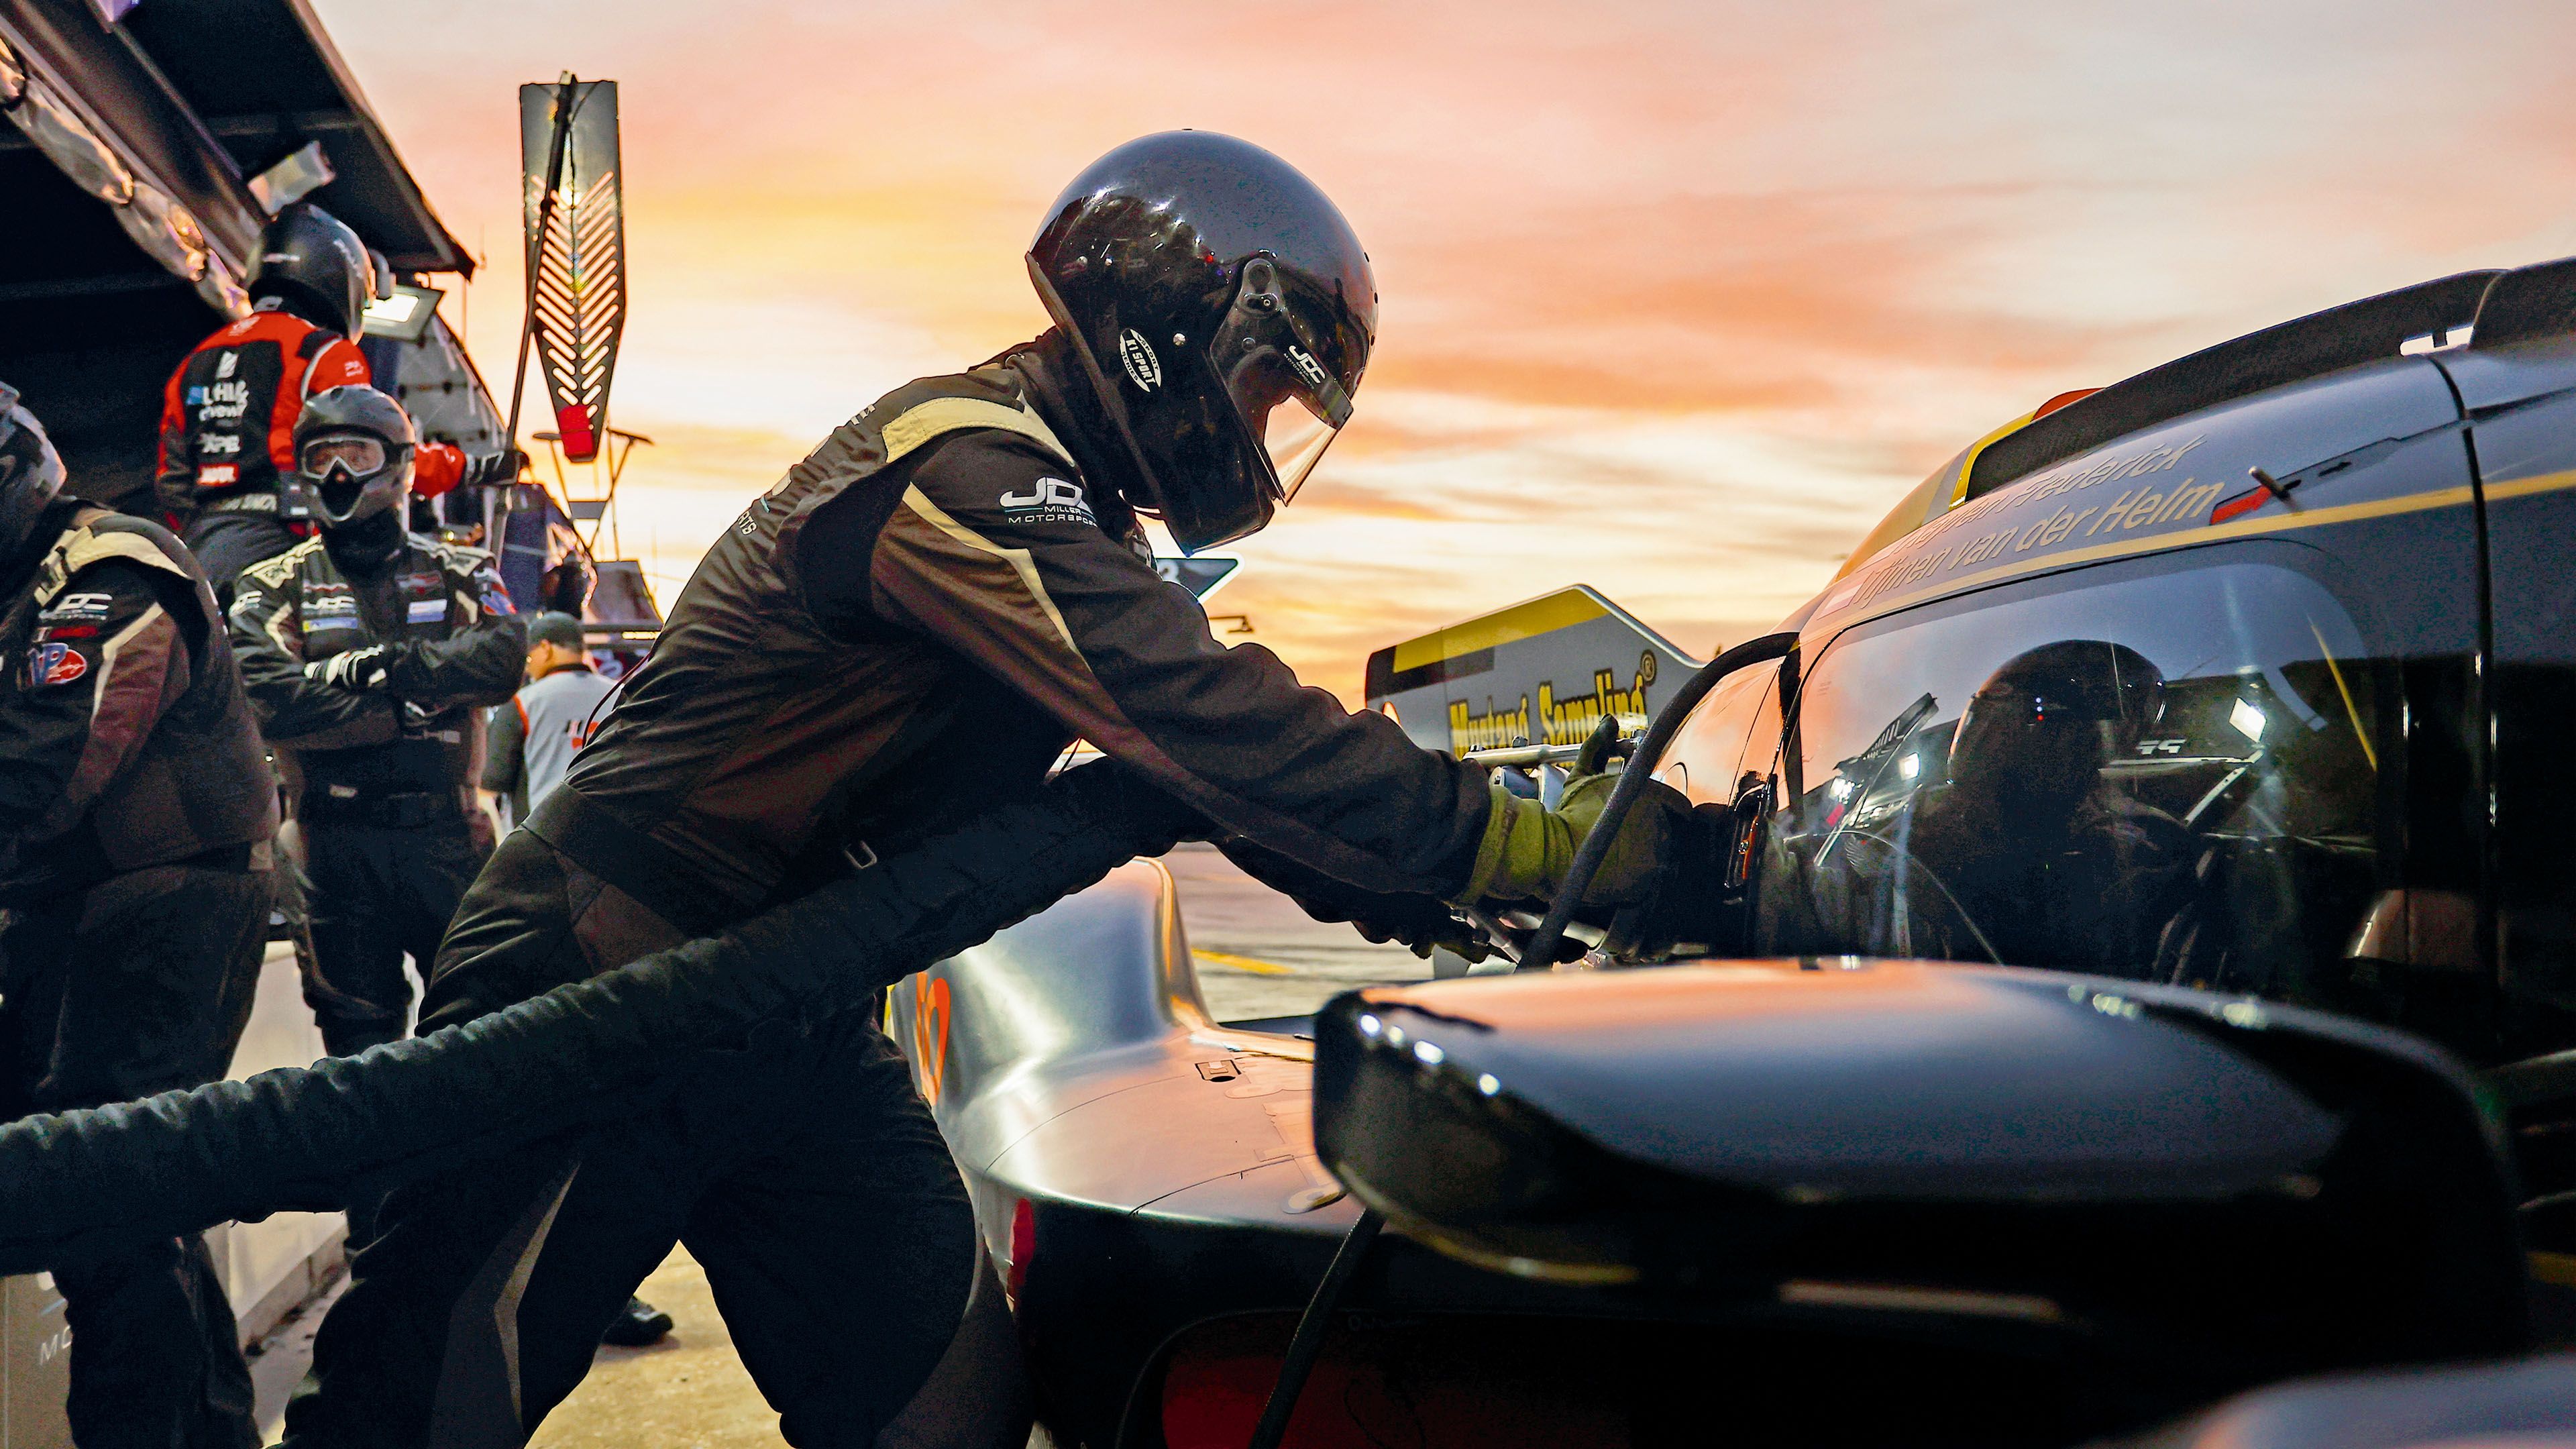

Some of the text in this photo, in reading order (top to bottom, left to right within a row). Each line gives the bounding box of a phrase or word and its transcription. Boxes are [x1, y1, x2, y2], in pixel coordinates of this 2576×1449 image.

[1122, 352, 1138, 381] SERIES
[1126, 339, 1156, 384] K1 SPORT
[1289, 345, 1326, 384] JDC
[2015, 433, 2208, 508] Frederick
[1000, 476, 1093, 515] JD
[1044, 505, 1083, 515] MILLER
[1948, 526, 2019, 571] van
[2015, 504, 2100, 552] der
[2086, 478, 2226, 537] Helm
